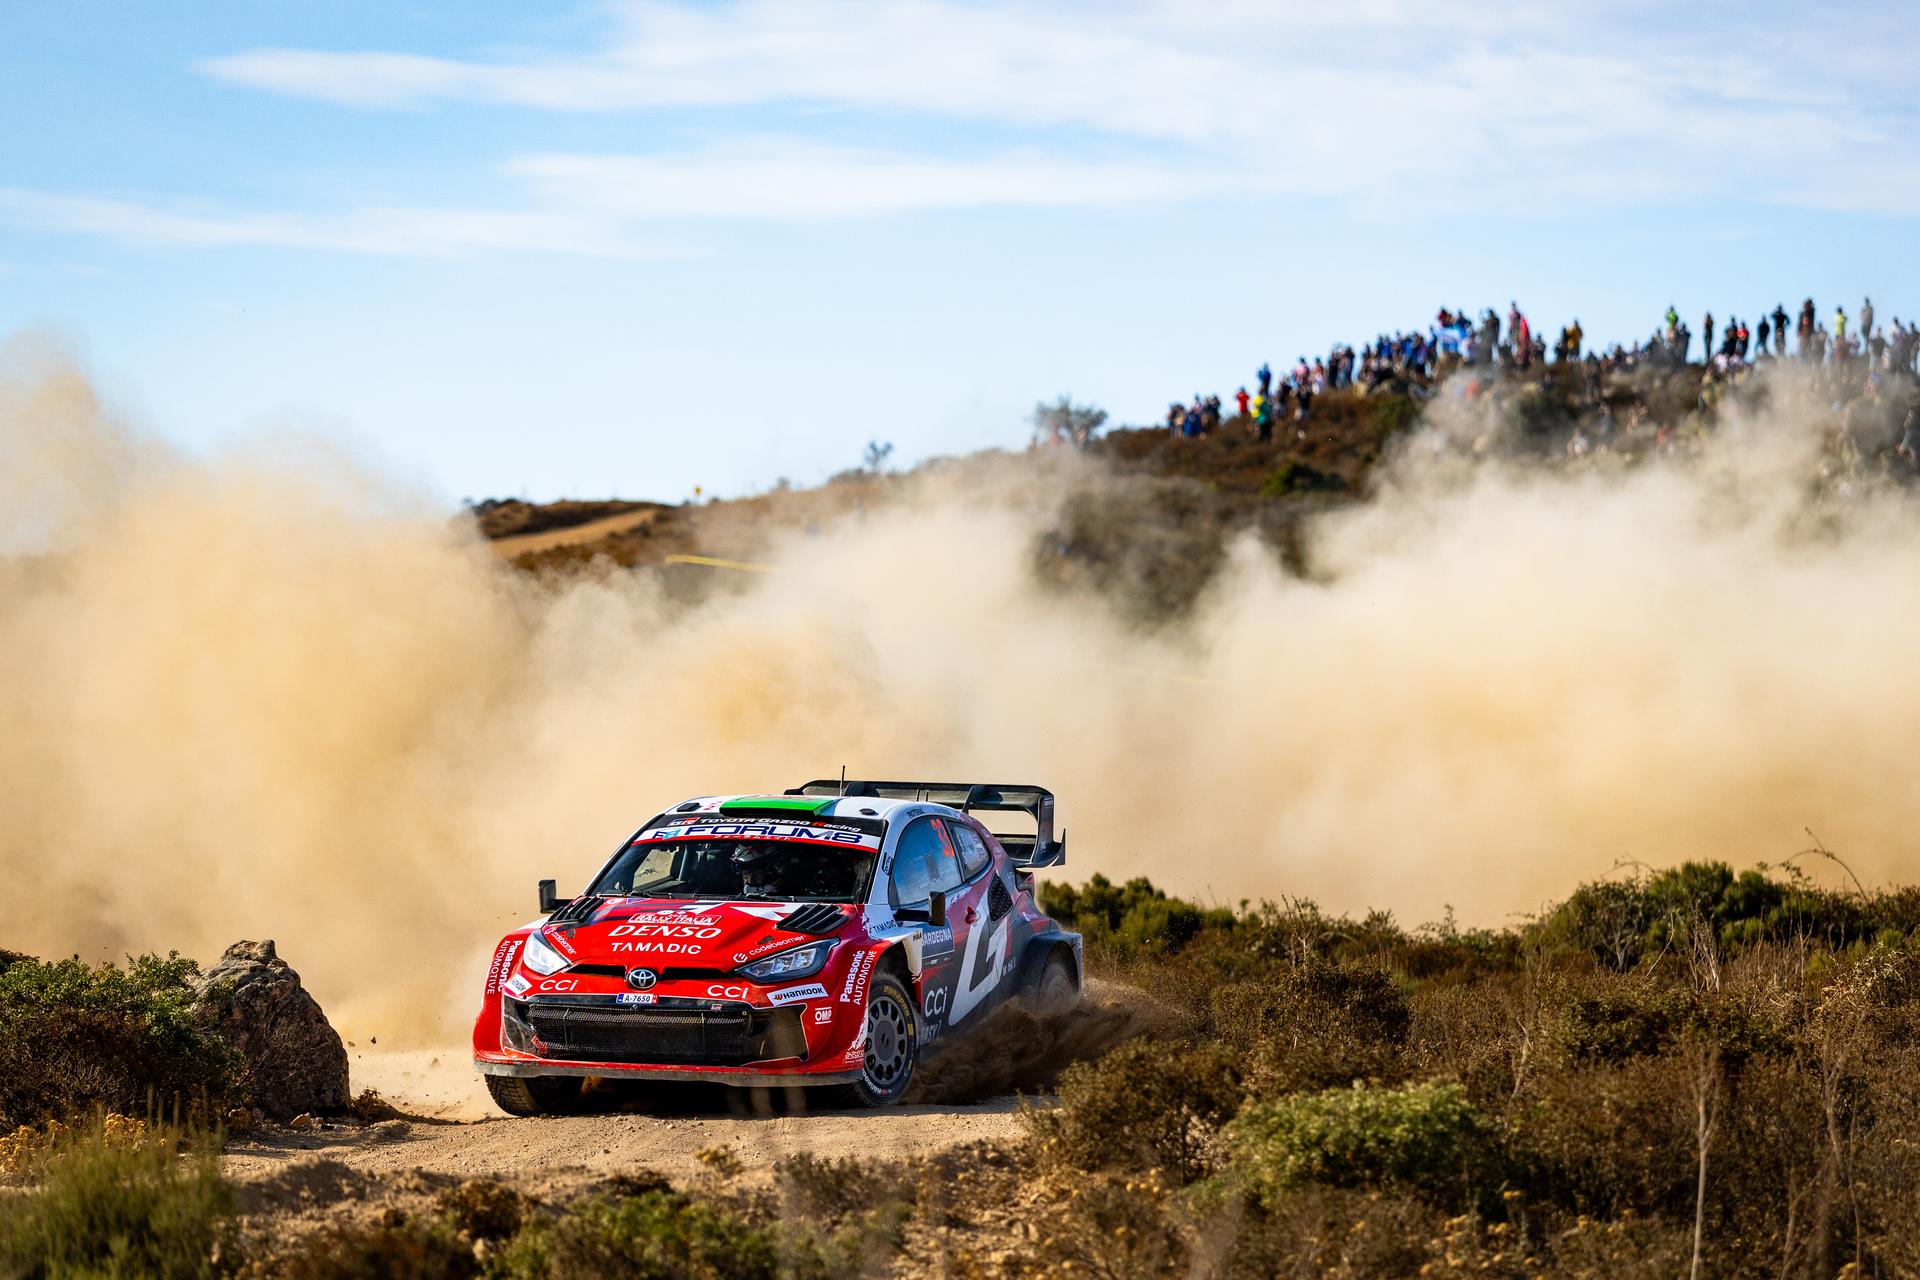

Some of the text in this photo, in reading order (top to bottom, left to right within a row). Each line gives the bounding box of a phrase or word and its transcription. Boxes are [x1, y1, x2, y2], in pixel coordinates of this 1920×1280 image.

[700, 817, 757, 825] TOYOTA
[758, 818, 812, 826] GAZOO
[812, 821, 862, 832] Racing
[684, 825, 863, 844] FORUM8
[930, 818, 955, 858] 33
[636, 914, 671, 923] RALLY
[673, 914, 713, 924] ITALIA
[607, 925, 722, 939] DENSO
[922, 928, 953, 947] SARDEGNA
[611, 942, 702, 955] TAMADIC
[749, 935, 806, 956] codebeamer
[487, 940, 511, 995] AUTOMOTIVE
[498, 940, 524, 993] Panasonic
[840, 950, 866, 1003] Panasonic
[853, 950, 878, 1005] AUTOMOTIVE
[624, 994, 651, 1003] A-7650
[815, 1008, 832, 1021] OMP
